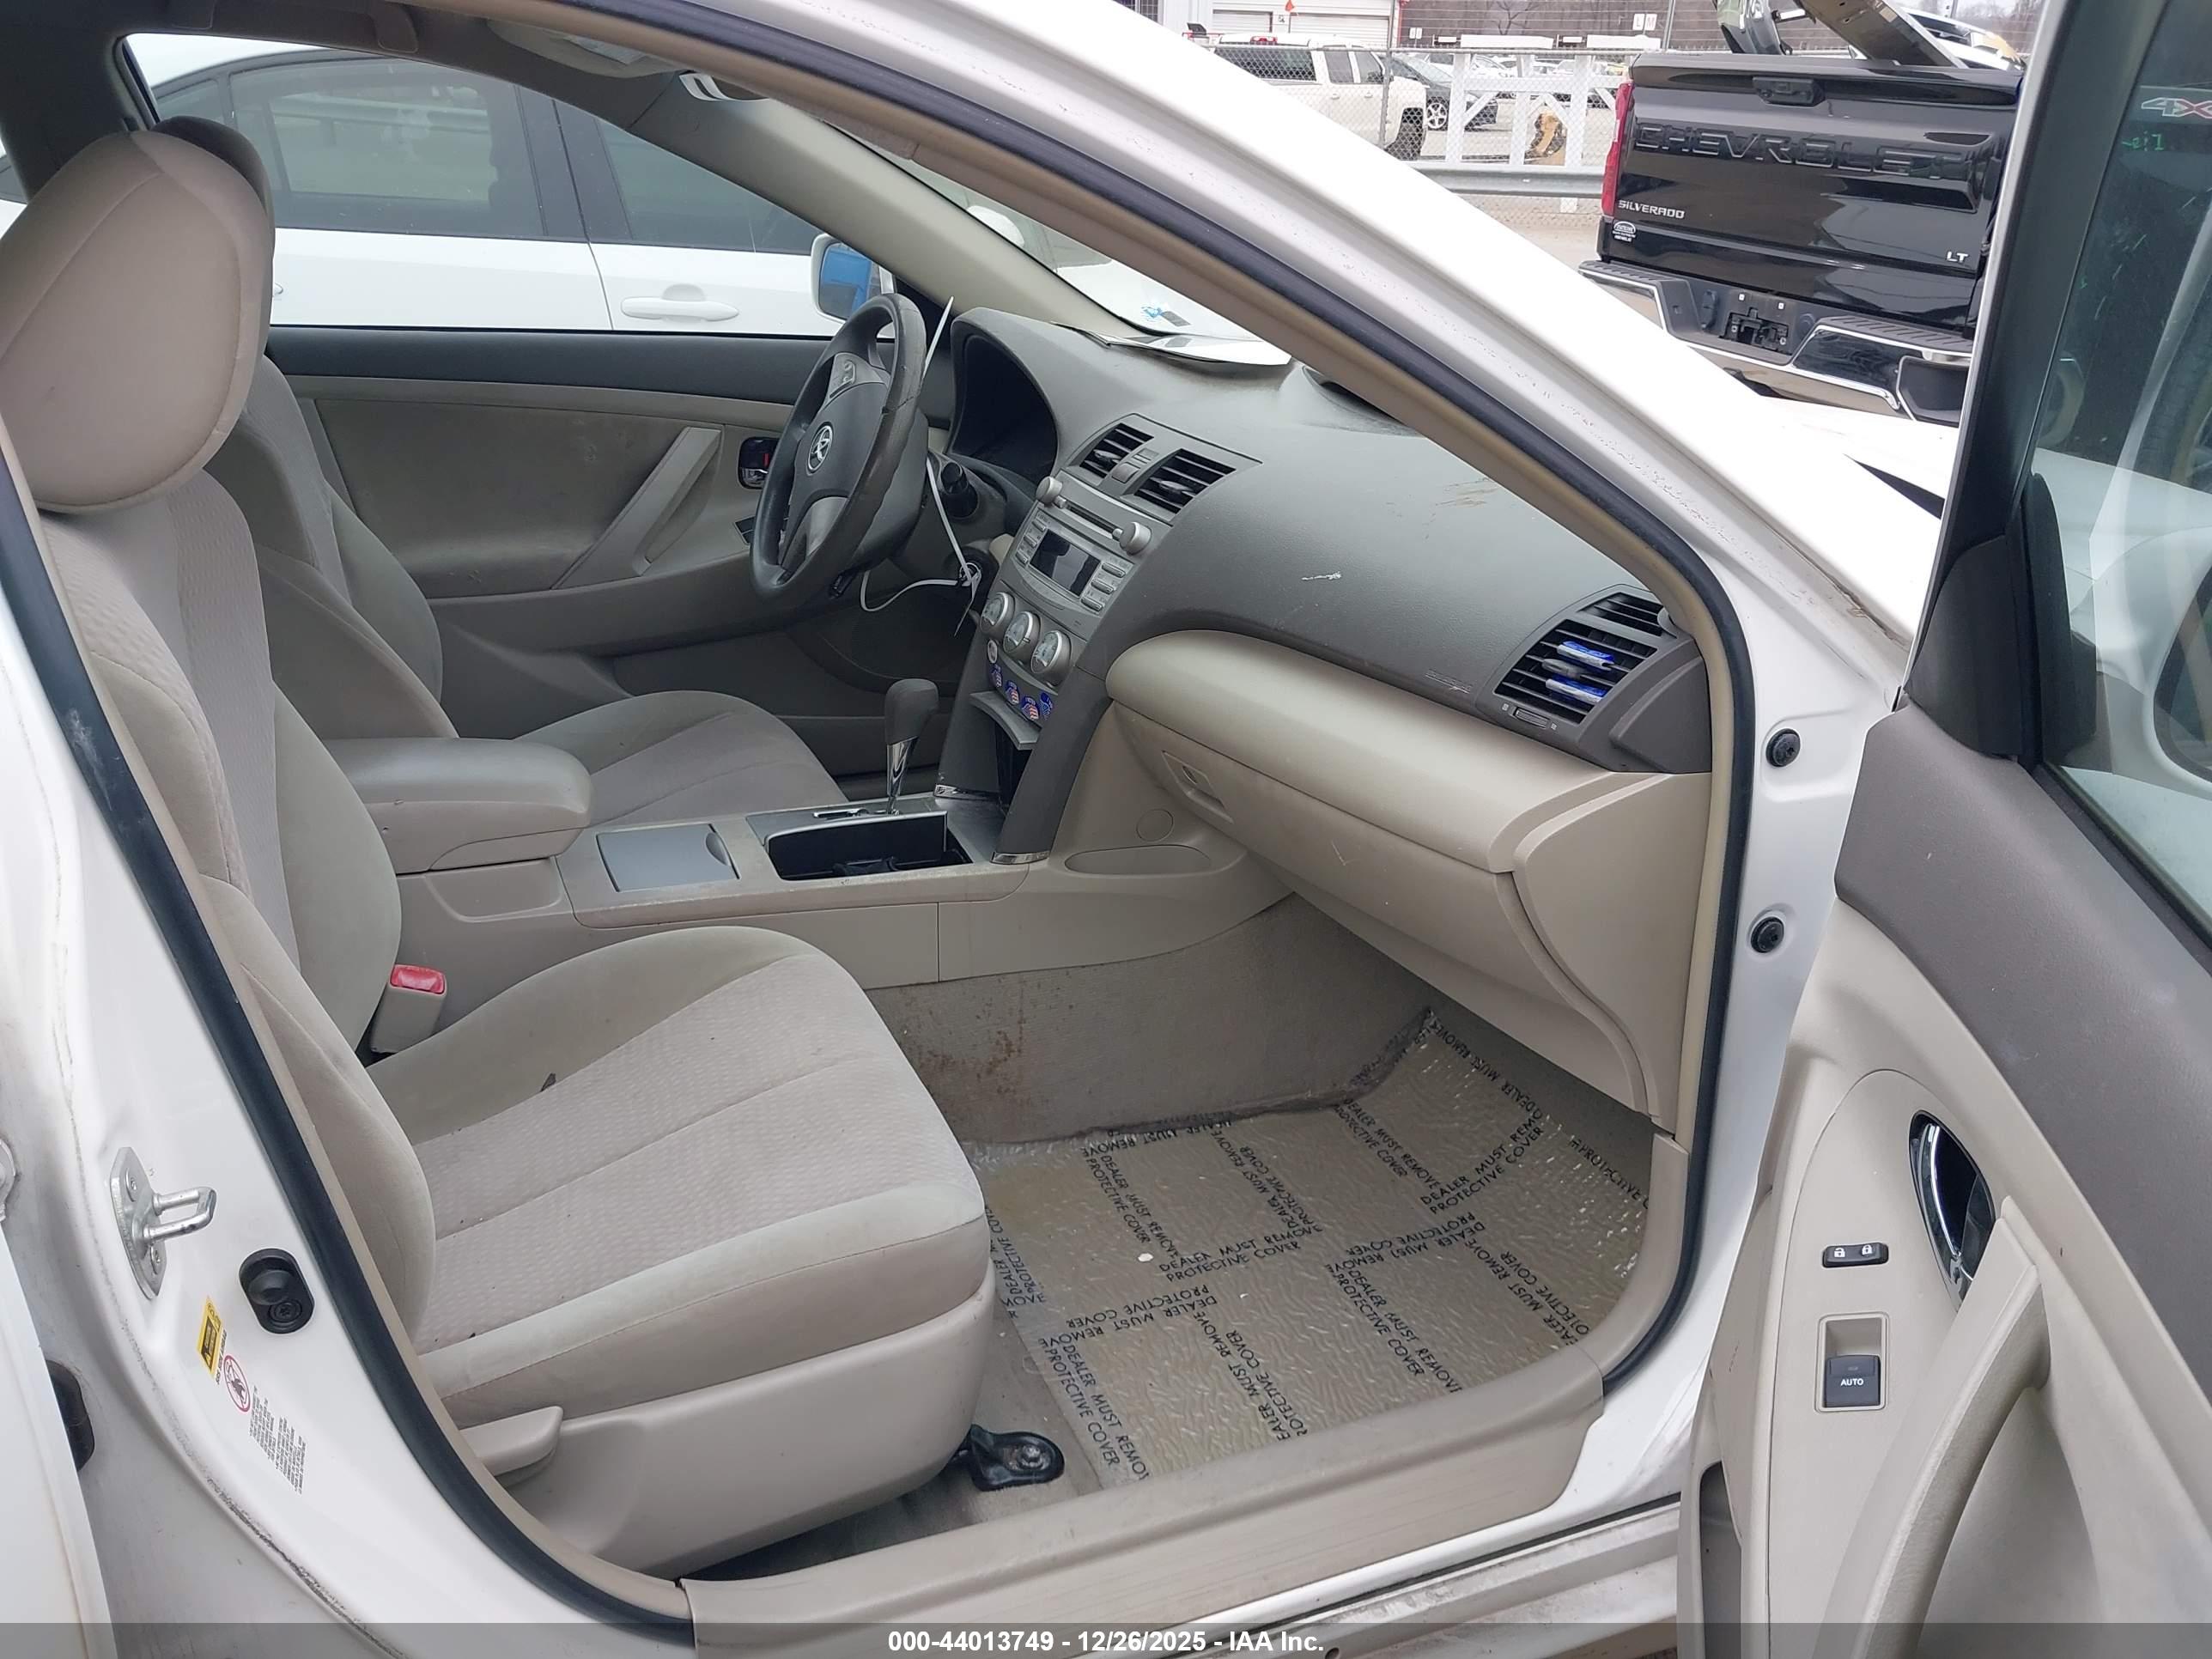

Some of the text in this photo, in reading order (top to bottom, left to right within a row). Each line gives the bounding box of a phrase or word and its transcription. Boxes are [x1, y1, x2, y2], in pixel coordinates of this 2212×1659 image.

[1635, 123, 1966, 179] CHEVROLET
[1619, 199, 1685, 219] SILVERADO
[1947, 251, 1968, 264] LT
[1211, 1130, 1246, 1169] REMOVE
[1239, 1146, 1269, 1176] COVER
[1375, 1127, 1404, 1152] MUST
[1401, 1152, 1442, 1190] REMOVE
[1376, 1149, 1408, 1178] COVER
[1429, 1126, 1545, 1215] PROTECTIVE COVER
[1242, 1170, 1271, 1194] MUST
[1420, 1175, 1470, 1206] DEALER
[1474, 1144, 1507, 1176] MUST
[1086, 1158, 1152, 1243] PROTECTIVE COVER
[1100, 1155, 1129, 1189] DEALER
[1126, 1194, 1152, 1218] MUST
[1147, 1221, 1182, 1260] REMOVE
[1159, 1225, 1323, 1273] DEALER MUST REMOVE
[1346, 1212, 1476, 1256] PROTECTIVE COVER
[1392, 1241, 1429, 1259] MUST
[1437, 1220, 1486, 1248] DEALER
[993, 1258, 1023, 1295] DEALER
[997, 1237, 1037, 1293] PROTECTIVE
[1166, 1241, 1302, 1283] PROTECTIVE COVER
[1463, 1237, 1511, 1281] REMOVE
[1499, 1250, 1539, 1286] COVER
[1066, 1285, 1210, 1329] PROTECTIVE COVER
[1348, 1269, 1388, 1307] DEALER
[1384, 1312, 1420, 1342] MUST
[1507, 1283, 1544, 1312] MUST
[1038, 1295, 1218, 1348] DEALER MUST REMOVE
[1192, 1310, 1231, 1358] REMOVE
[1333, 1273, 1425, 1376] PROTECTIVE COVER
[1225, 1329, 1261, 1370] COVER
[1062, 1343, 1097, 1388] DEALER
[1090, 1394, 1123, 1428] MUST
[1227, 1363, 1261, 1398] MUST
[1840, 1378, 1864, 1387] AUTO
[1047, 1349, 1121, 1467] PROTECTIVE COVER
